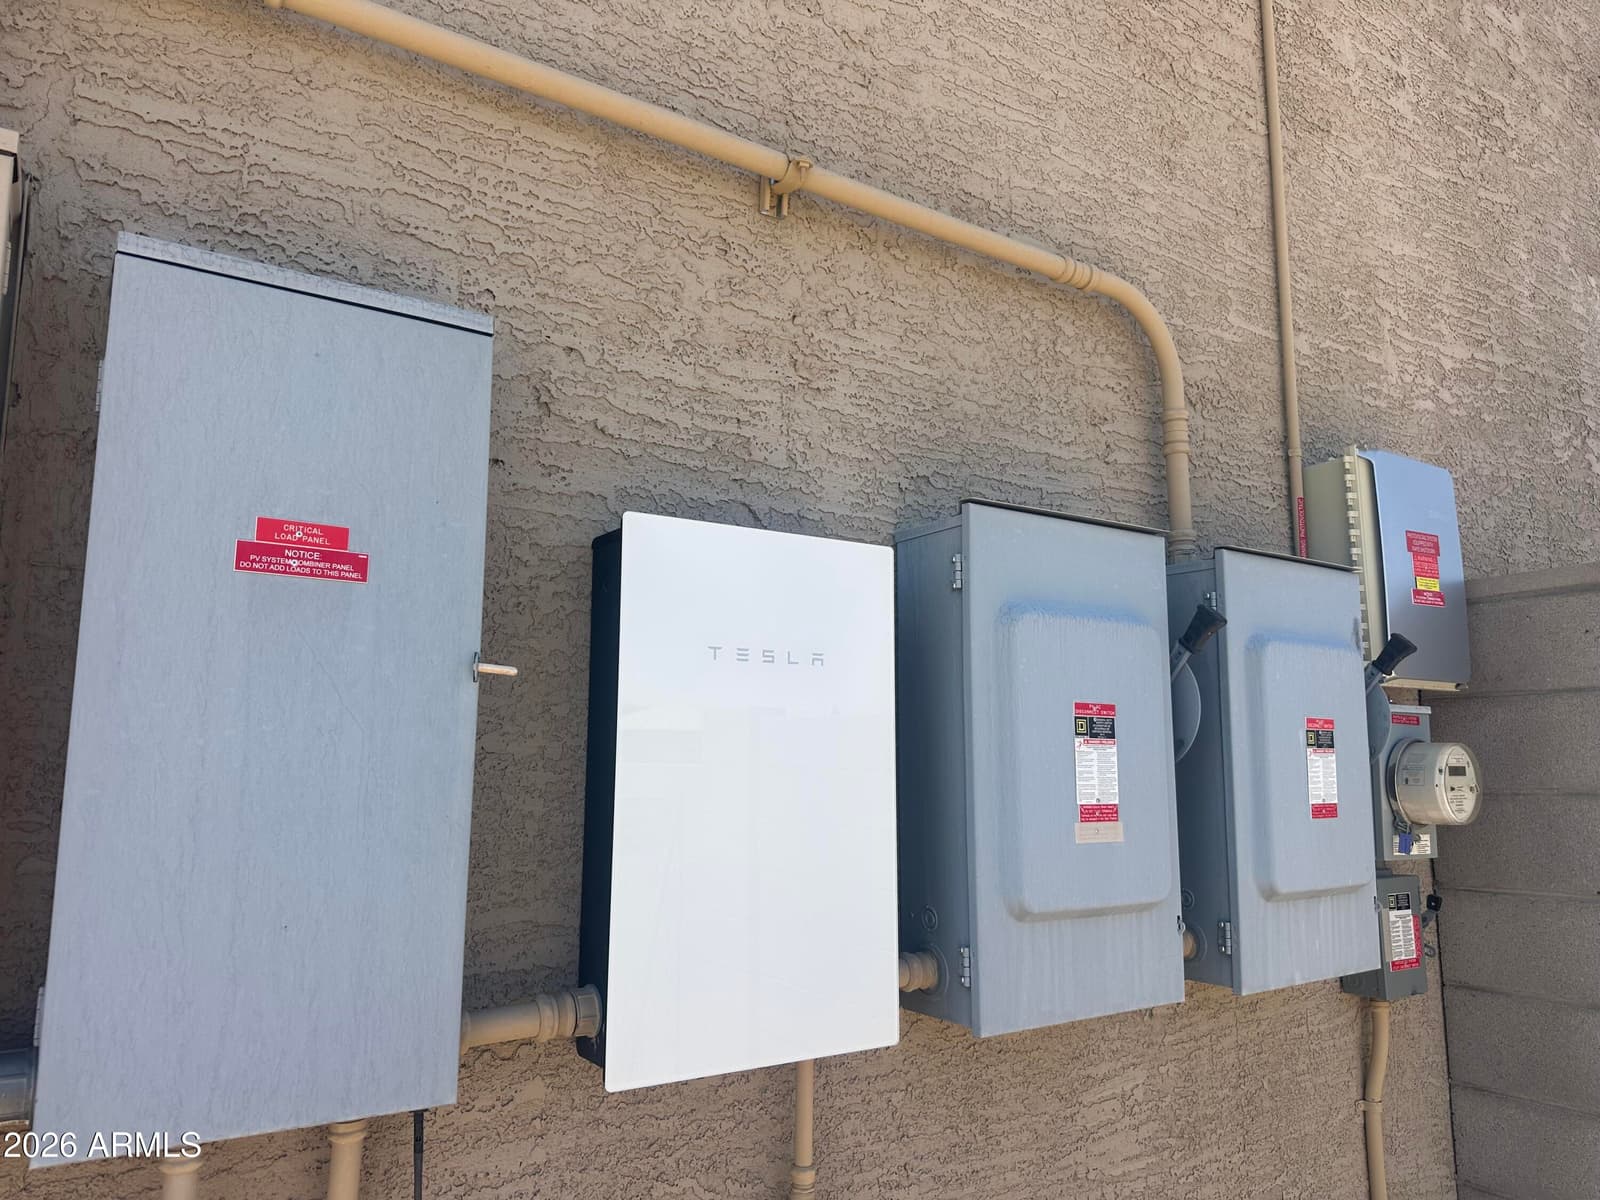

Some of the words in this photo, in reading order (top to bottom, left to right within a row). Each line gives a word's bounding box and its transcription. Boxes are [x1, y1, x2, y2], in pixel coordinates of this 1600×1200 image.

[284, 524, 323, 535] CRITICAL
[275, 533, 297, 541] LOAD
[302, 536, 331, 545] PANEL
[262, 556, 292, 564] SYSTEM
[293, 559, 333, 569] OMBINER
[332, 563, 354, 571] PANEL
[269, 563, 285, 571] ADD
[286, 565, 311, 574] LOADS
[324, 569, 339, 577] THIS
[341, 571, 363, 579] PANEL
[707, 645, 824, 666] TESLA
